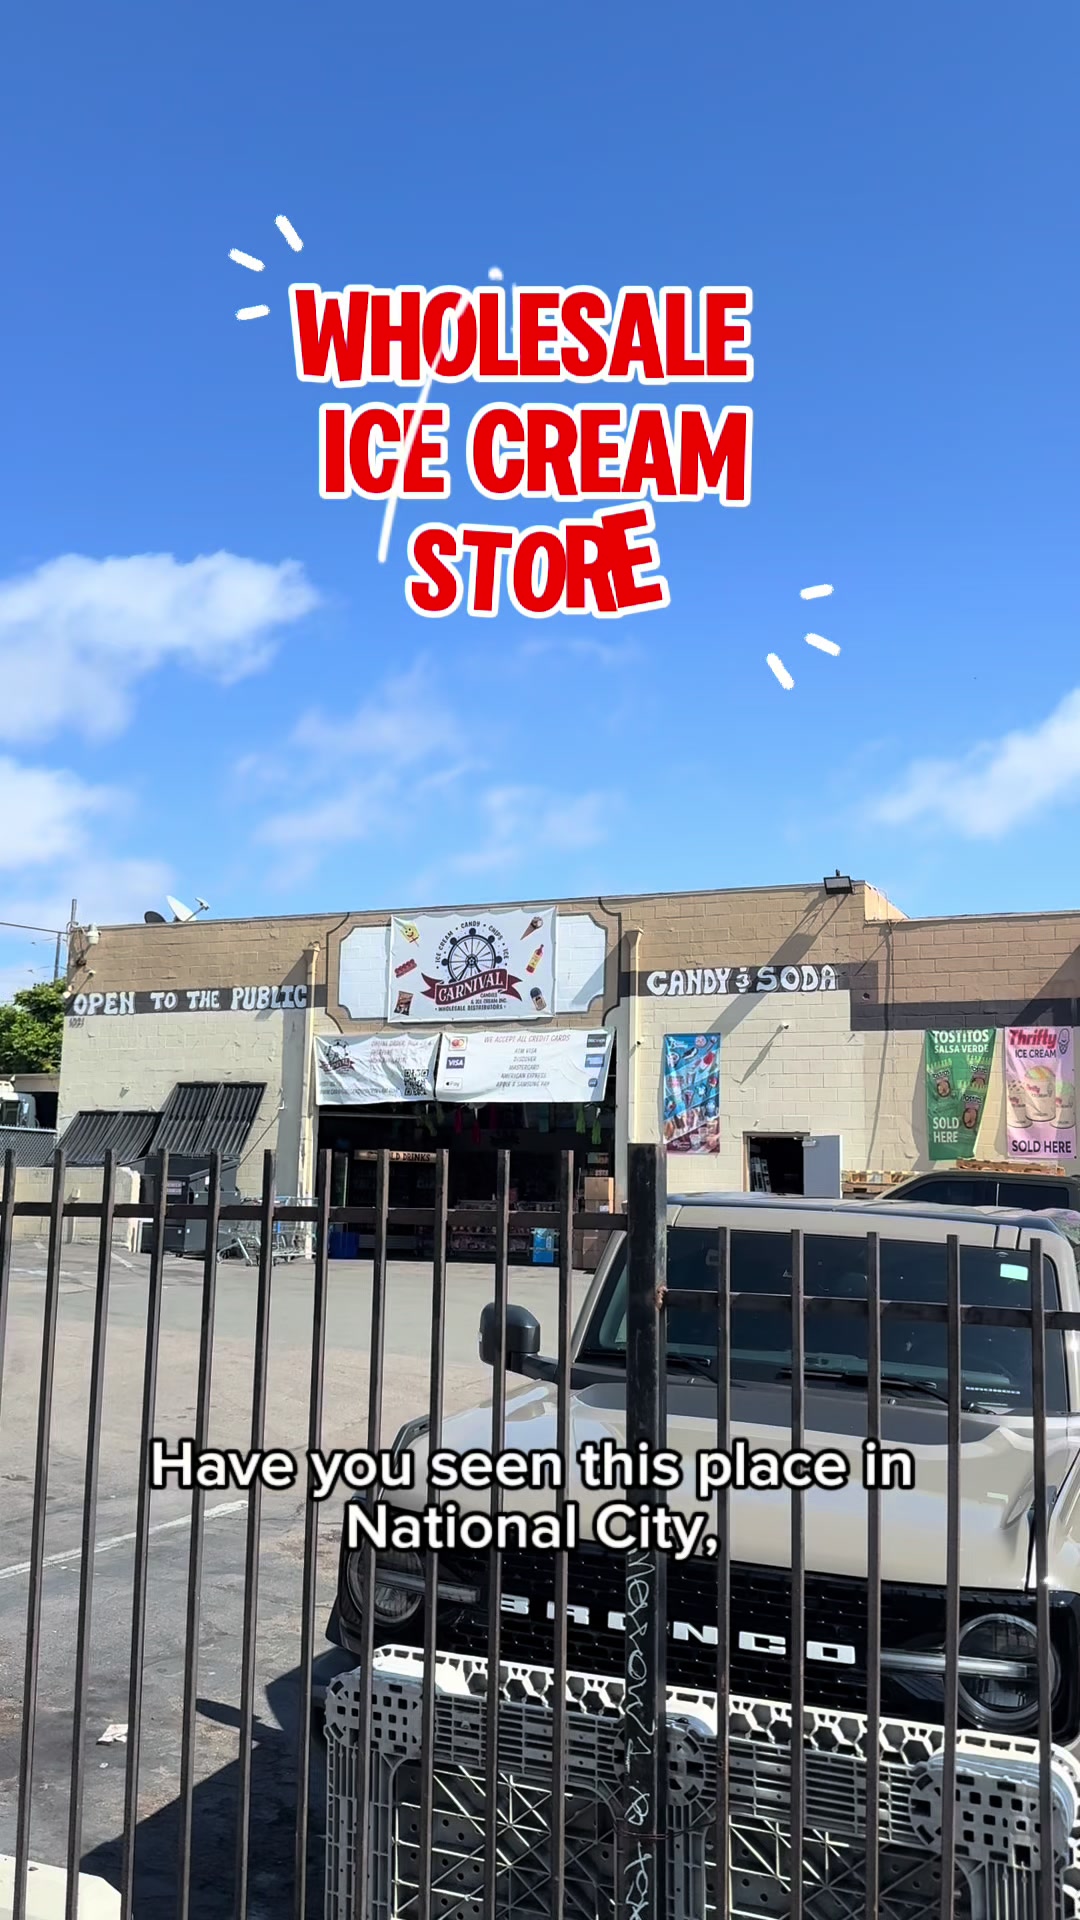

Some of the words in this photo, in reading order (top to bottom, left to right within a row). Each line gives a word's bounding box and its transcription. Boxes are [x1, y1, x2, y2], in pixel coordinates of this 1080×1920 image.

[438, 930, 454, 951] CREAM
[460, 920, 480, 928] CANDY
[488, 925, 504, 941] CHIPS
[438, 971, 503, 1002] CARNIVAL
[646, 968, 732, 996] CANDY
[756, 964, 838, 993] SODA
[73, 992, 136, 1015] OPEN
[150, 992, 178, 1010] TO
[187, 990, 220, 1010] THE
[231, 985, 307, 1010] PUBLIC
[495, 1035, 517, 1043] ACCEPT
[551, 1034, 571, 1042] CARDS
[932, 1029, 989, 1044] TOSTITOS
[1009, 1029, 1057, 1049] Thrifty
[934, 1044, 960, 1054] SALSA
[961, 1044, 989, 1053] VERDE
[1015, 1049, 1028, 1058] ICE
[1029, 1049, 1057, 1058] CREAM
[933, 1117, 960, 1129] SOLD
[933, 1131, 958, 1143] HERE
[1012, 1140, 1041, 1152] SOLD
[1044, 1141, 1072, 1153] HERE
[403, 1153, 431, 1161] DRINKS
